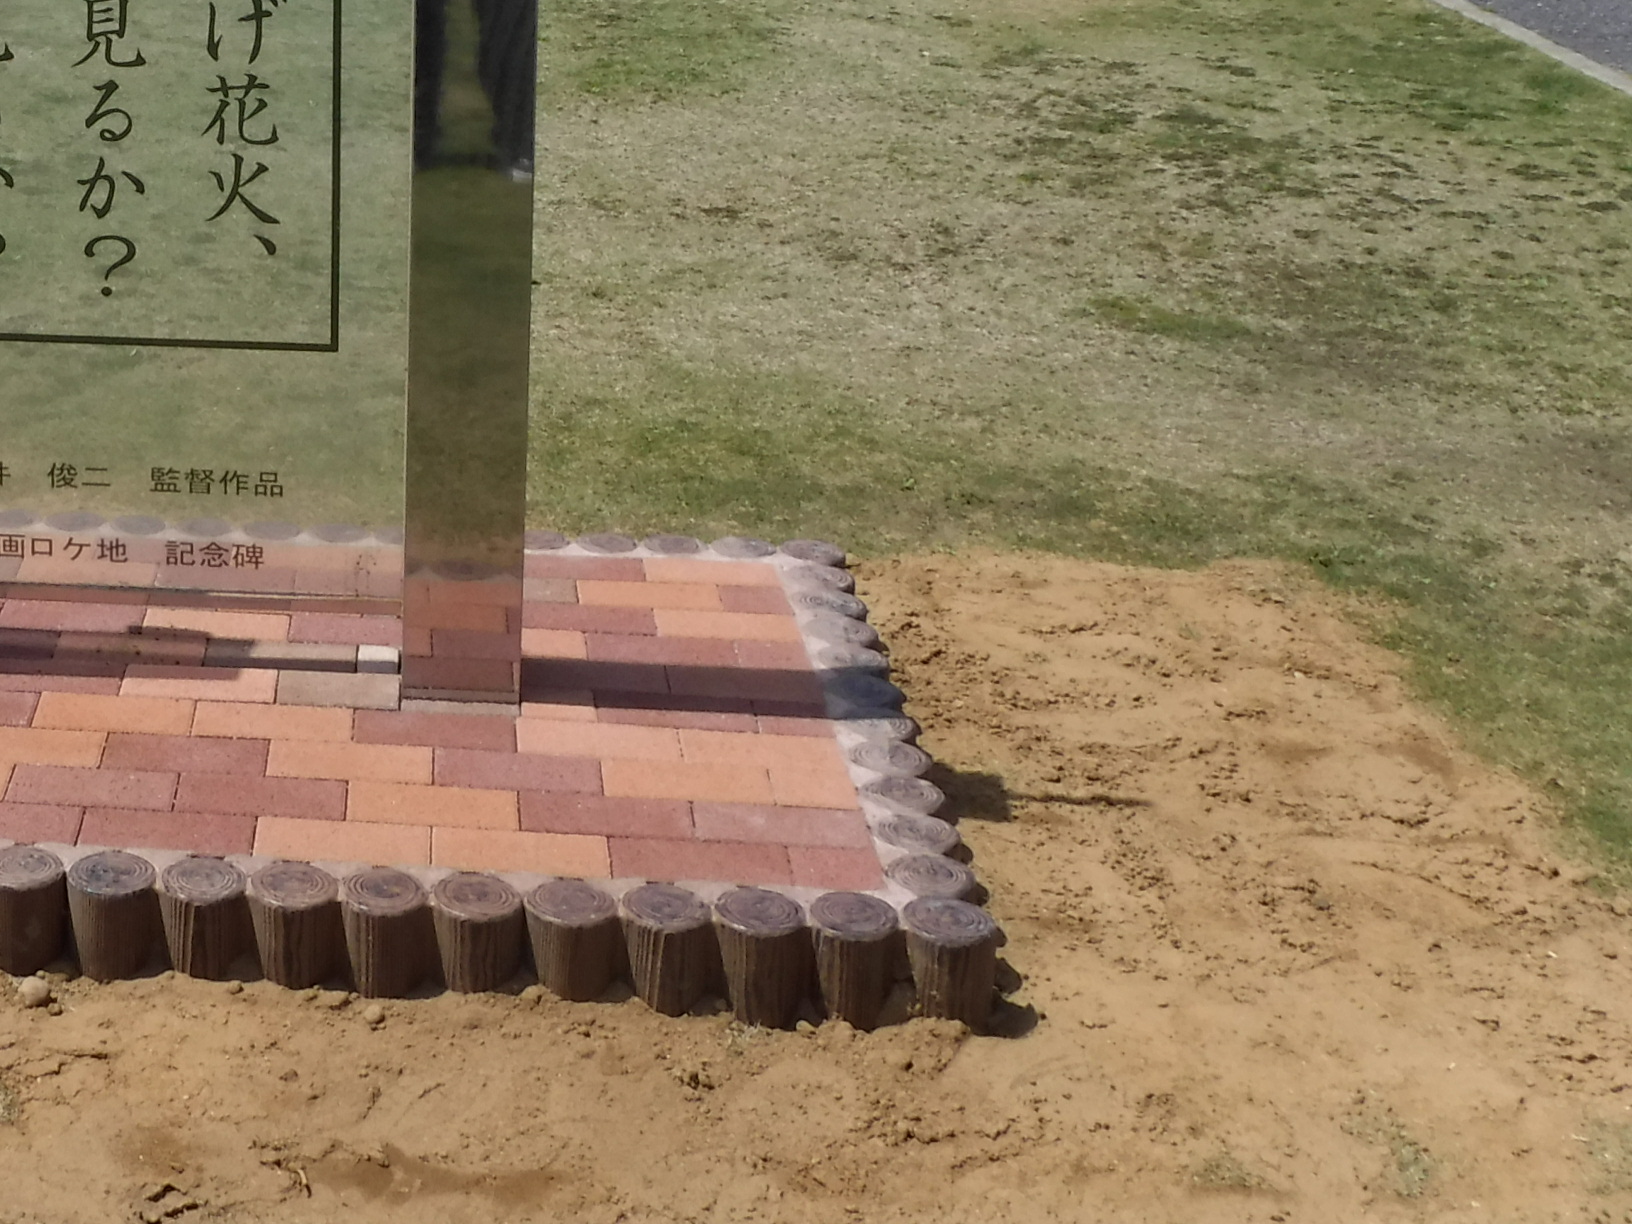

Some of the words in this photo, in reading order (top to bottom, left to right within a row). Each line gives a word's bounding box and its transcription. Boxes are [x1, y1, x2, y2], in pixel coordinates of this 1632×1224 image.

[46, 461, 112, 489] 俊二
[149, 466, 285, 498] 監督作品
[164, 539, 265, 571] 記念碑
